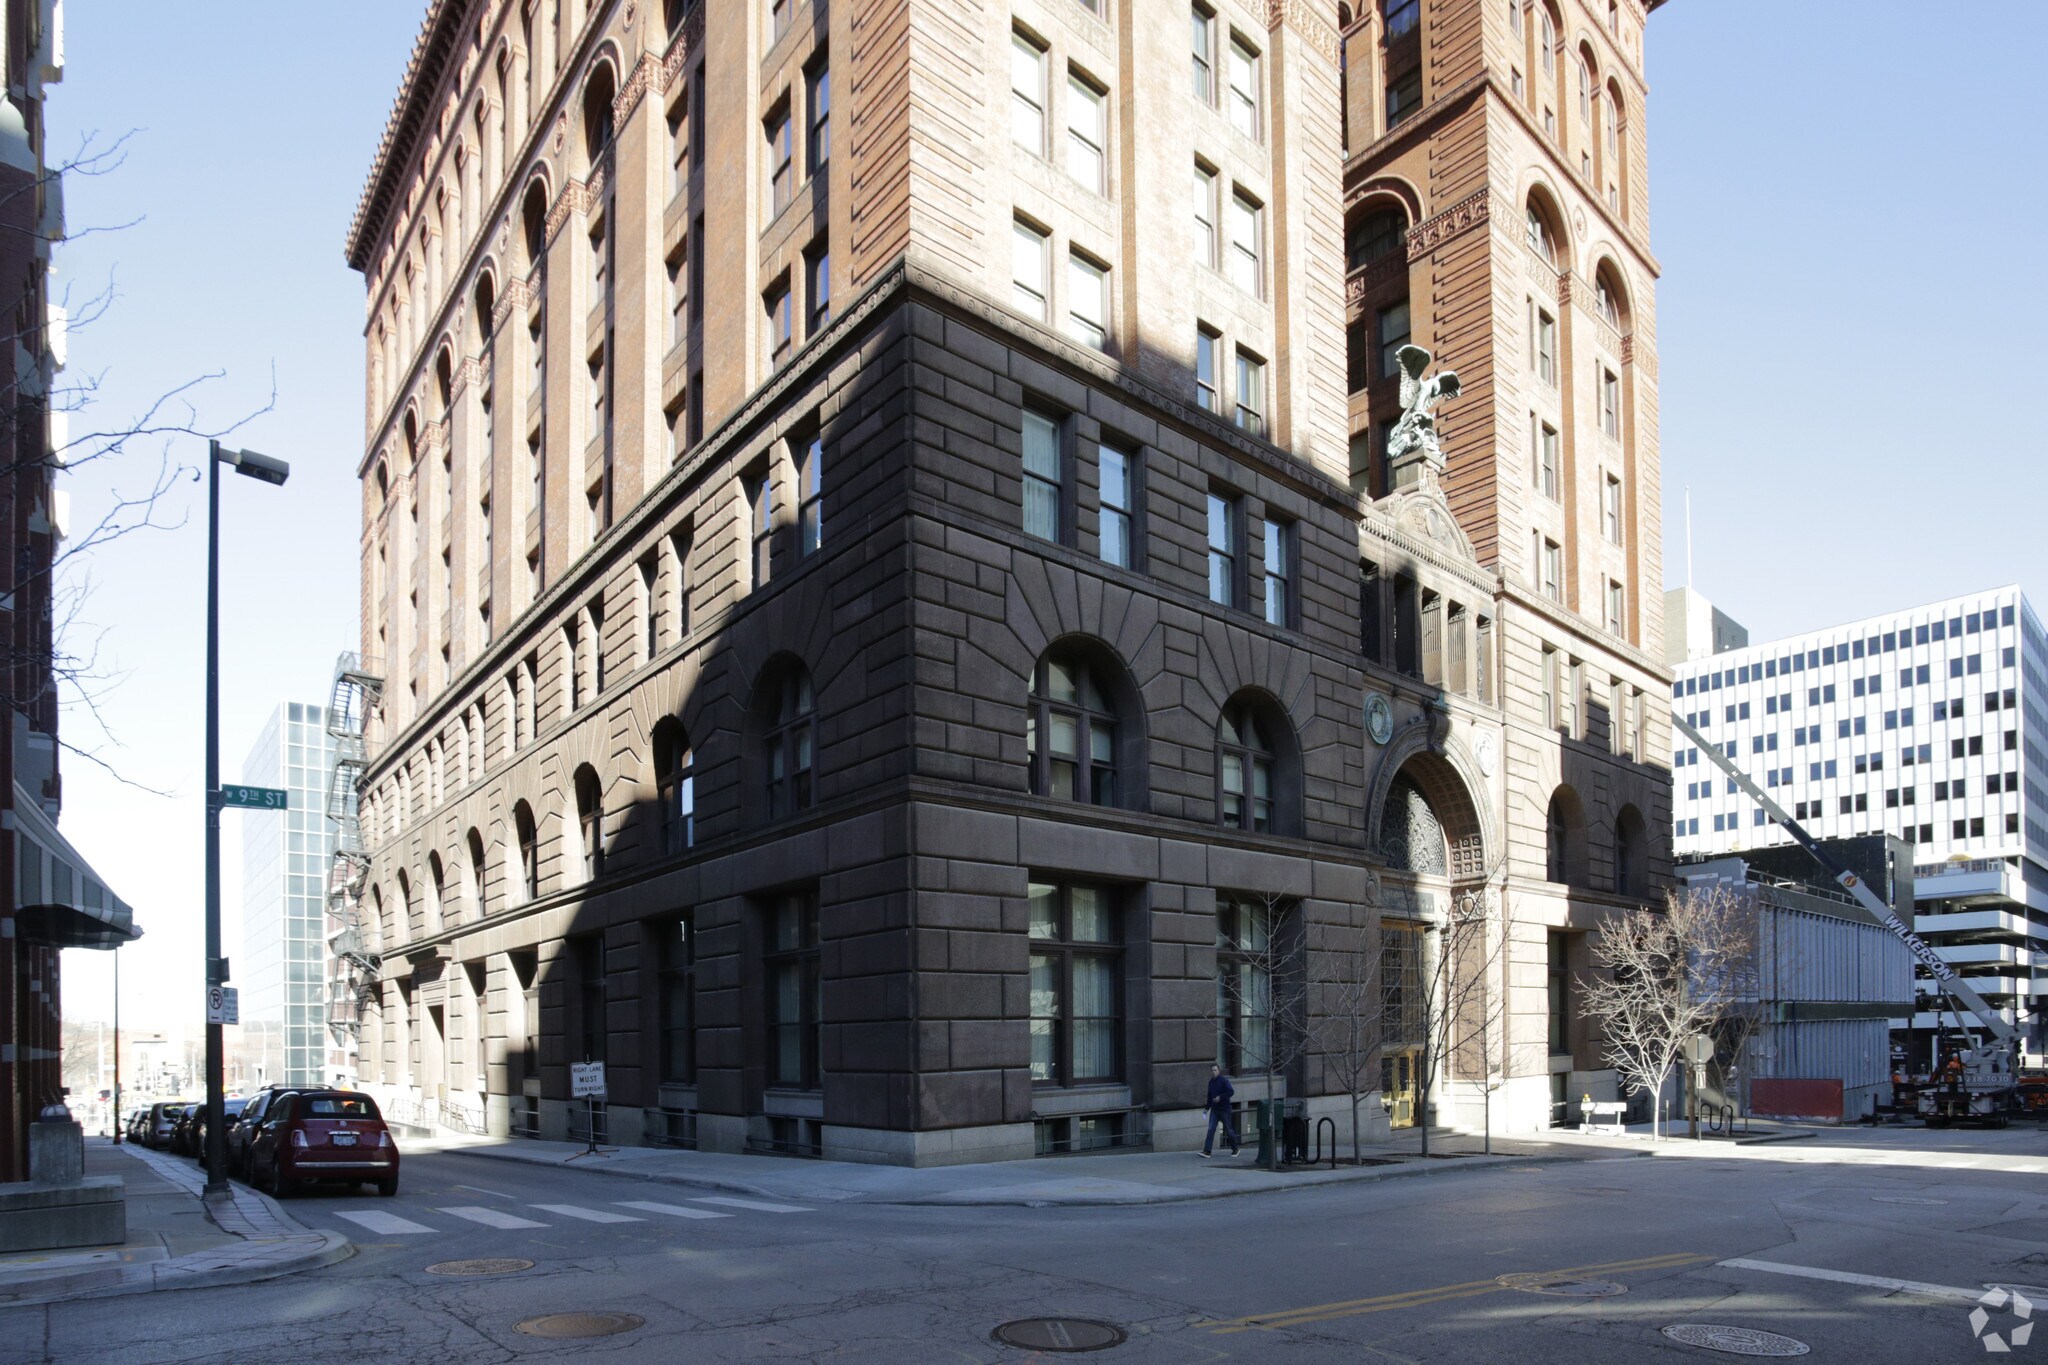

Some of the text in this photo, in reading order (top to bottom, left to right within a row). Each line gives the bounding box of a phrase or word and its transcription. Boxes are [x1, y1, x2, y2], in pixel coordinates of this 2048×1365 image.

[239, 789, 259, 803] 9TH
[265, 791, 283, 806] ST
[1883, 914, 1955, 982] WILKERSON
[579, 1075, 597, 1083] MUST
